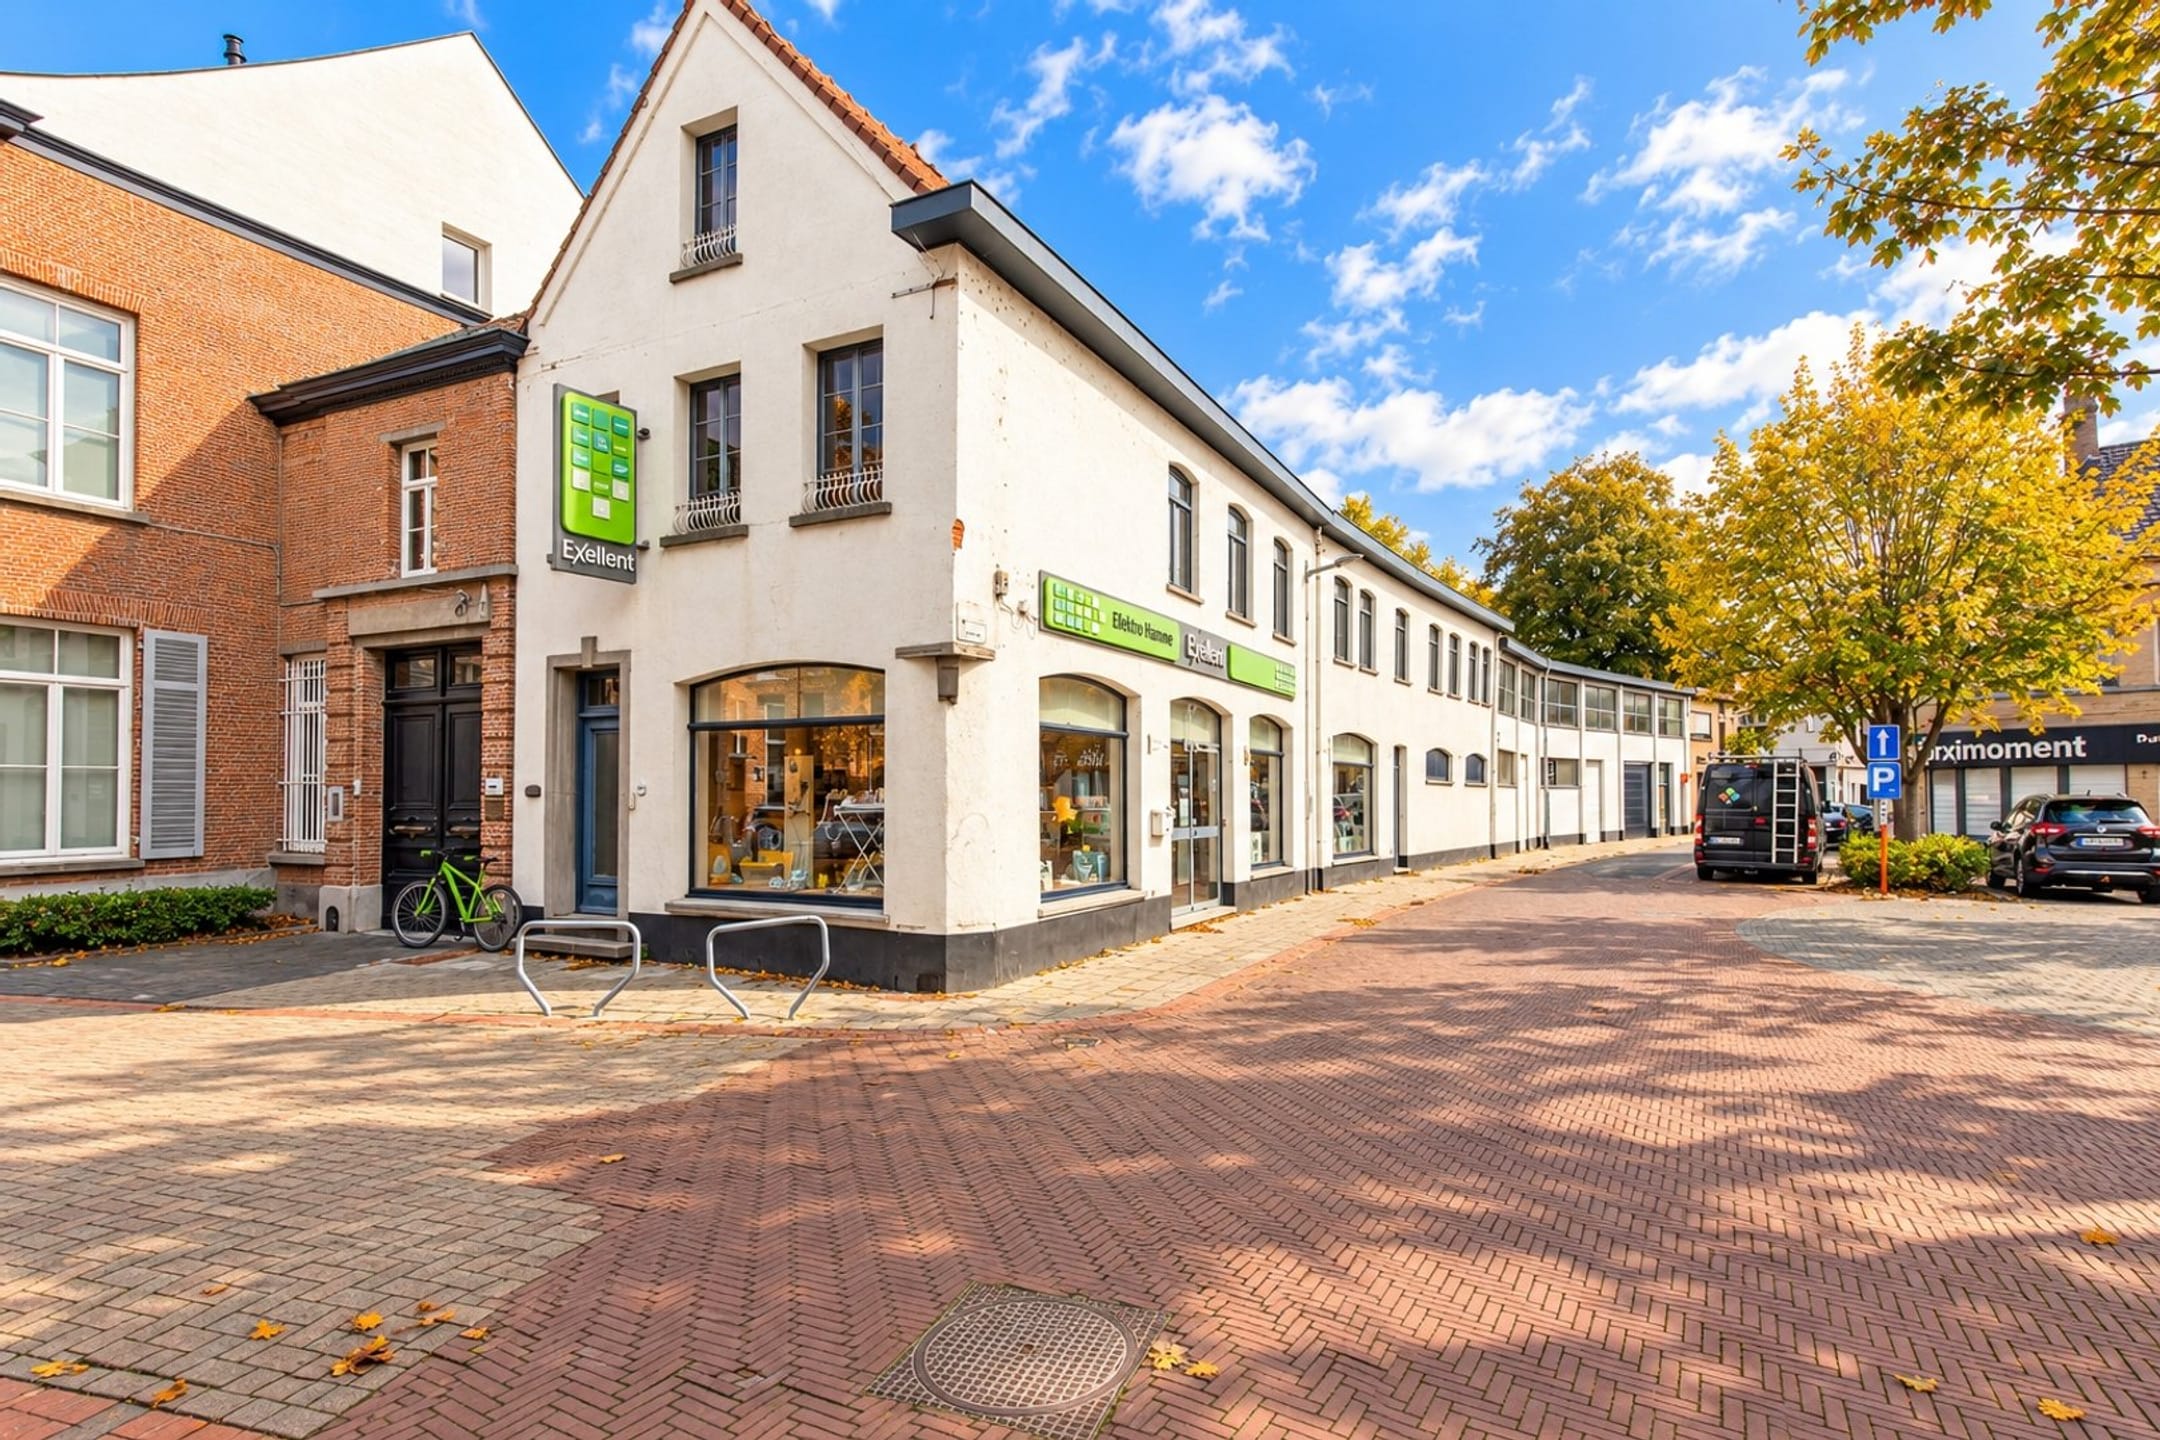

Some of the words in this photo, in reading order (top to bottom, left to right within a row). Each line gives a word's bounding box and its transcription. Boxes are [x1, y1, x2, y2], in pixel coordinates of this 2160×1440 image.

[1112, 611, 1143, 636] Elektro
[1145, 622, 1173, 647] Hamme
[1873, 767, 1895, 792] P
